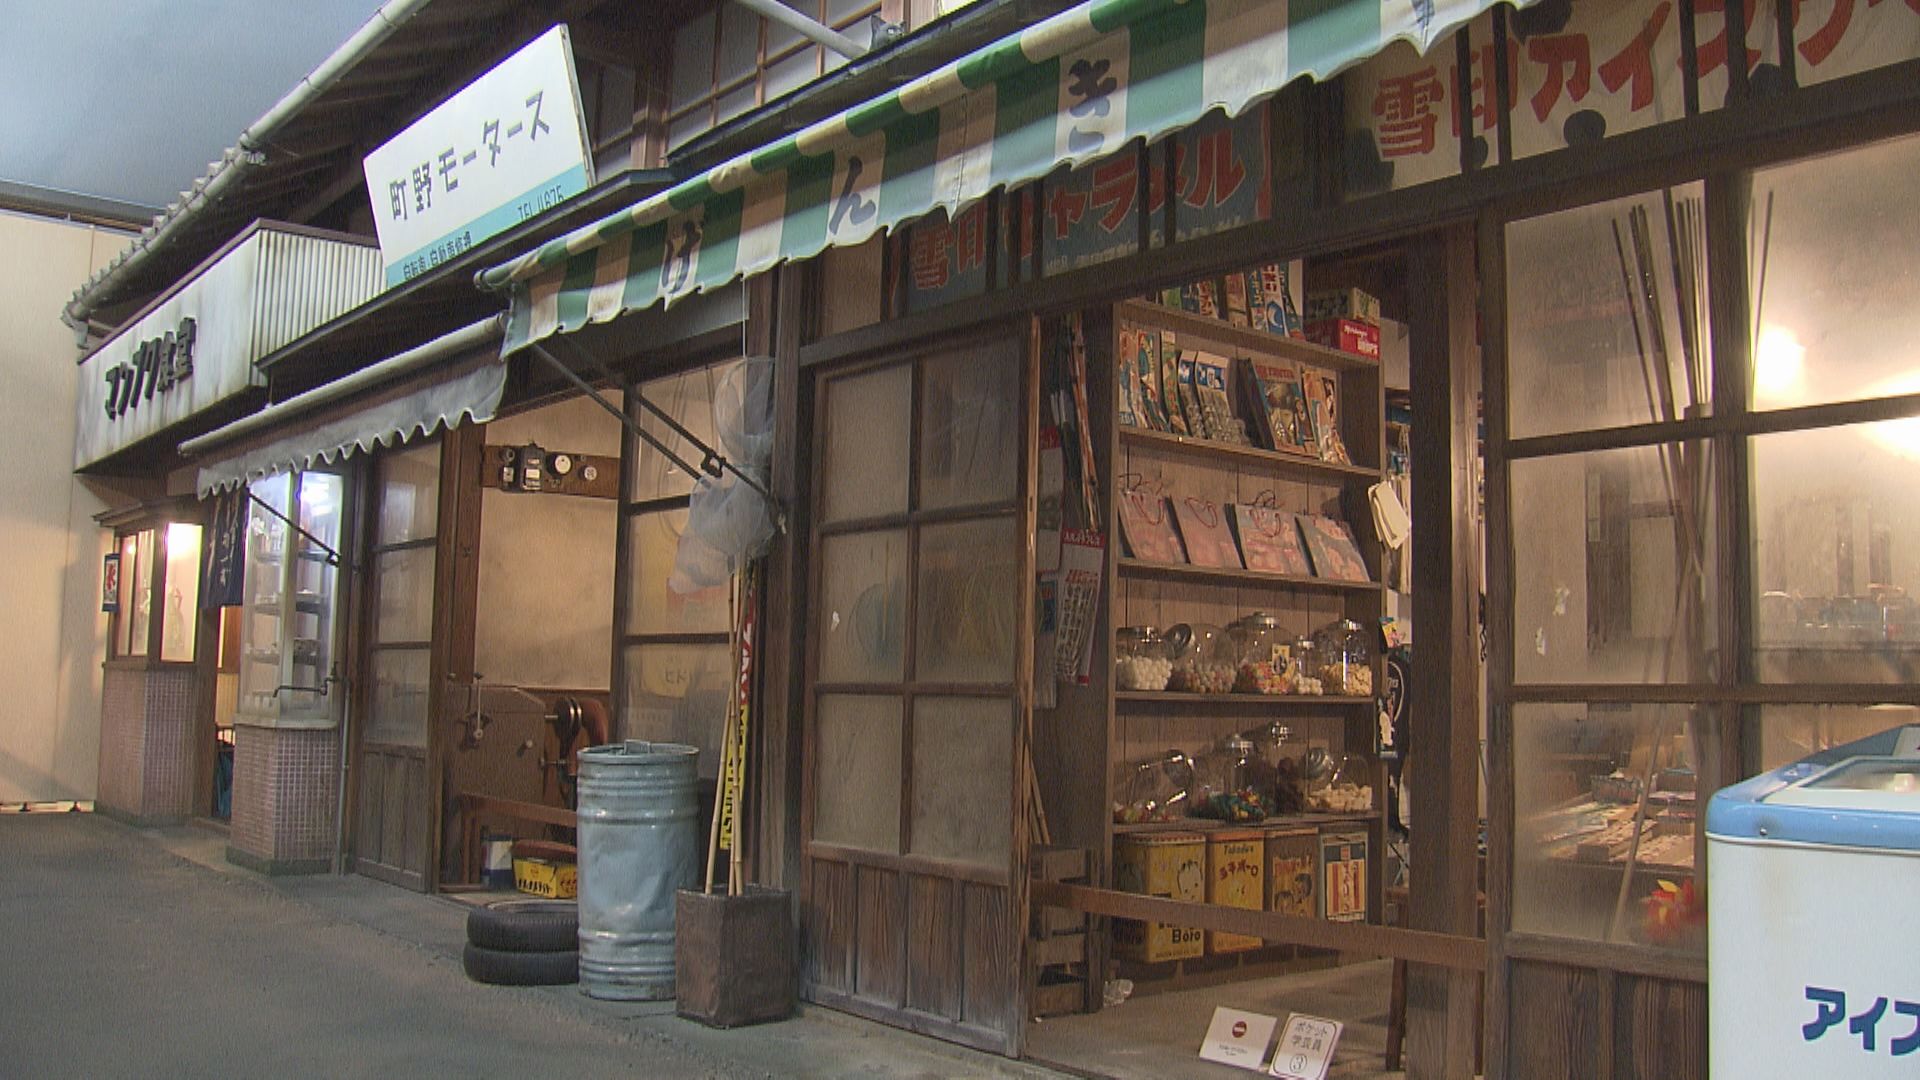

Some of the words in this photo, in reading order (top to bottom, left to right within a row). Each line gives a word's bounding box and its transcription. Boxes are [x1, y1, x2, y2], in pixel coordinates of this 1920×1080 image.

[389, 90, 550, 222] 町野モータース
